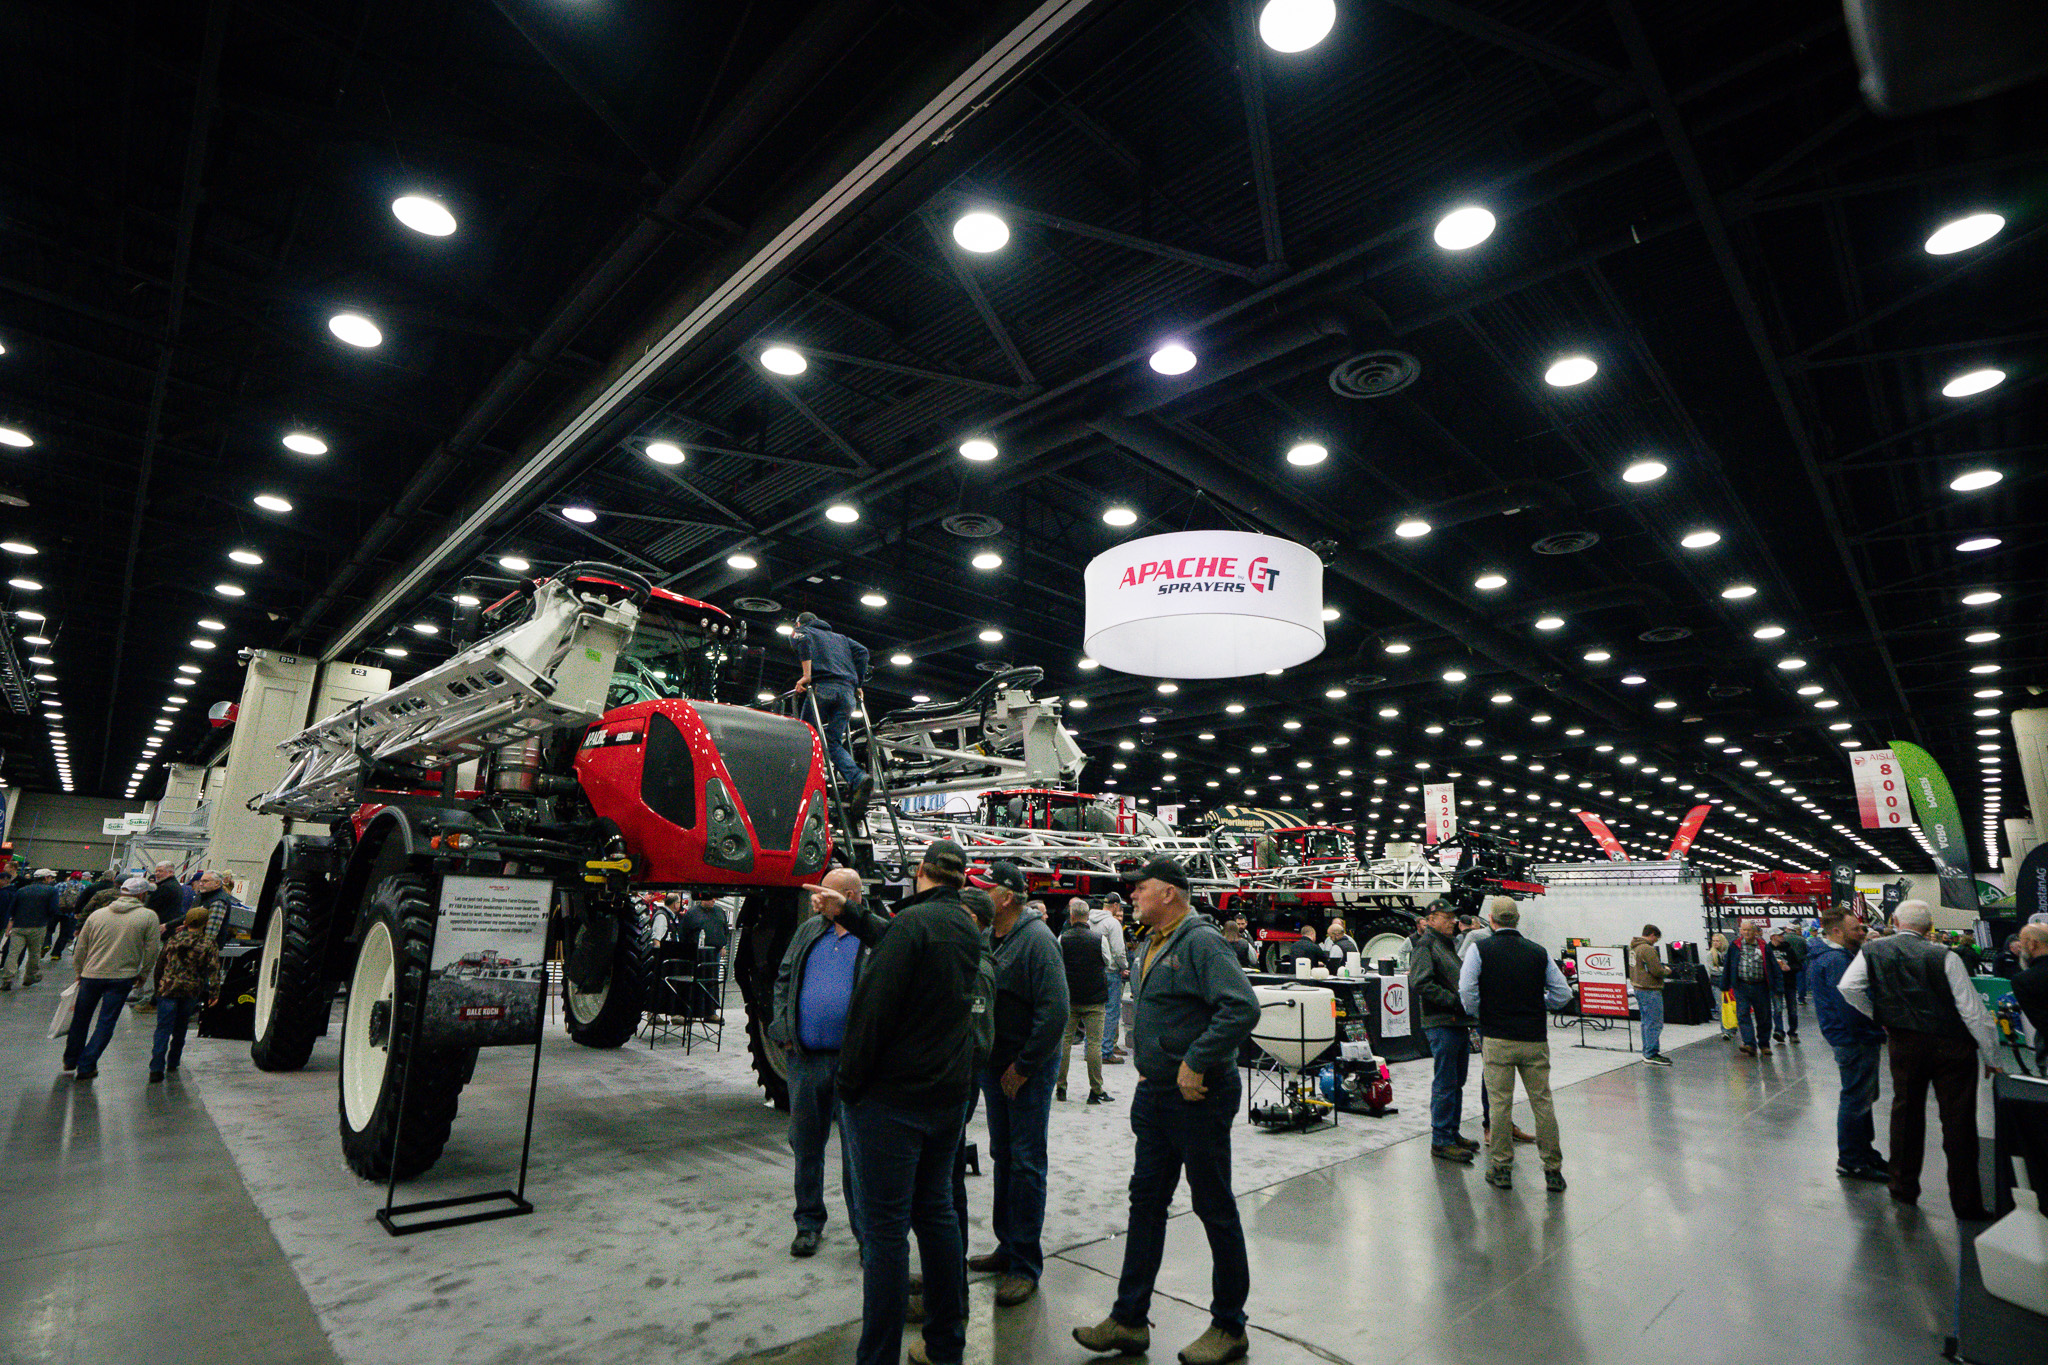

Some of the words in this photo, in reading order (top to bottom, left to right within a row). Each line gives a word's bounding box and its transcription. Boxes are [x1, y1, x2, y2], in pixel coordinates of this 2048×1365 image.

[1119, 557, 1238, 589] APACHE
[1157, 581, 1246, 595] SPRAYERS
[280, 656, 295, 664] B14
[353, 668, 365, 676] C2
[1869, 753, 1897, 761] AISLE
[1221, 818, 1265, 828] Worthington
[1769, 905, 1814, 915] GRAIN
[1591, 957, 1611, 966] OVA
[466, 1008, 482, 1016] DALE
